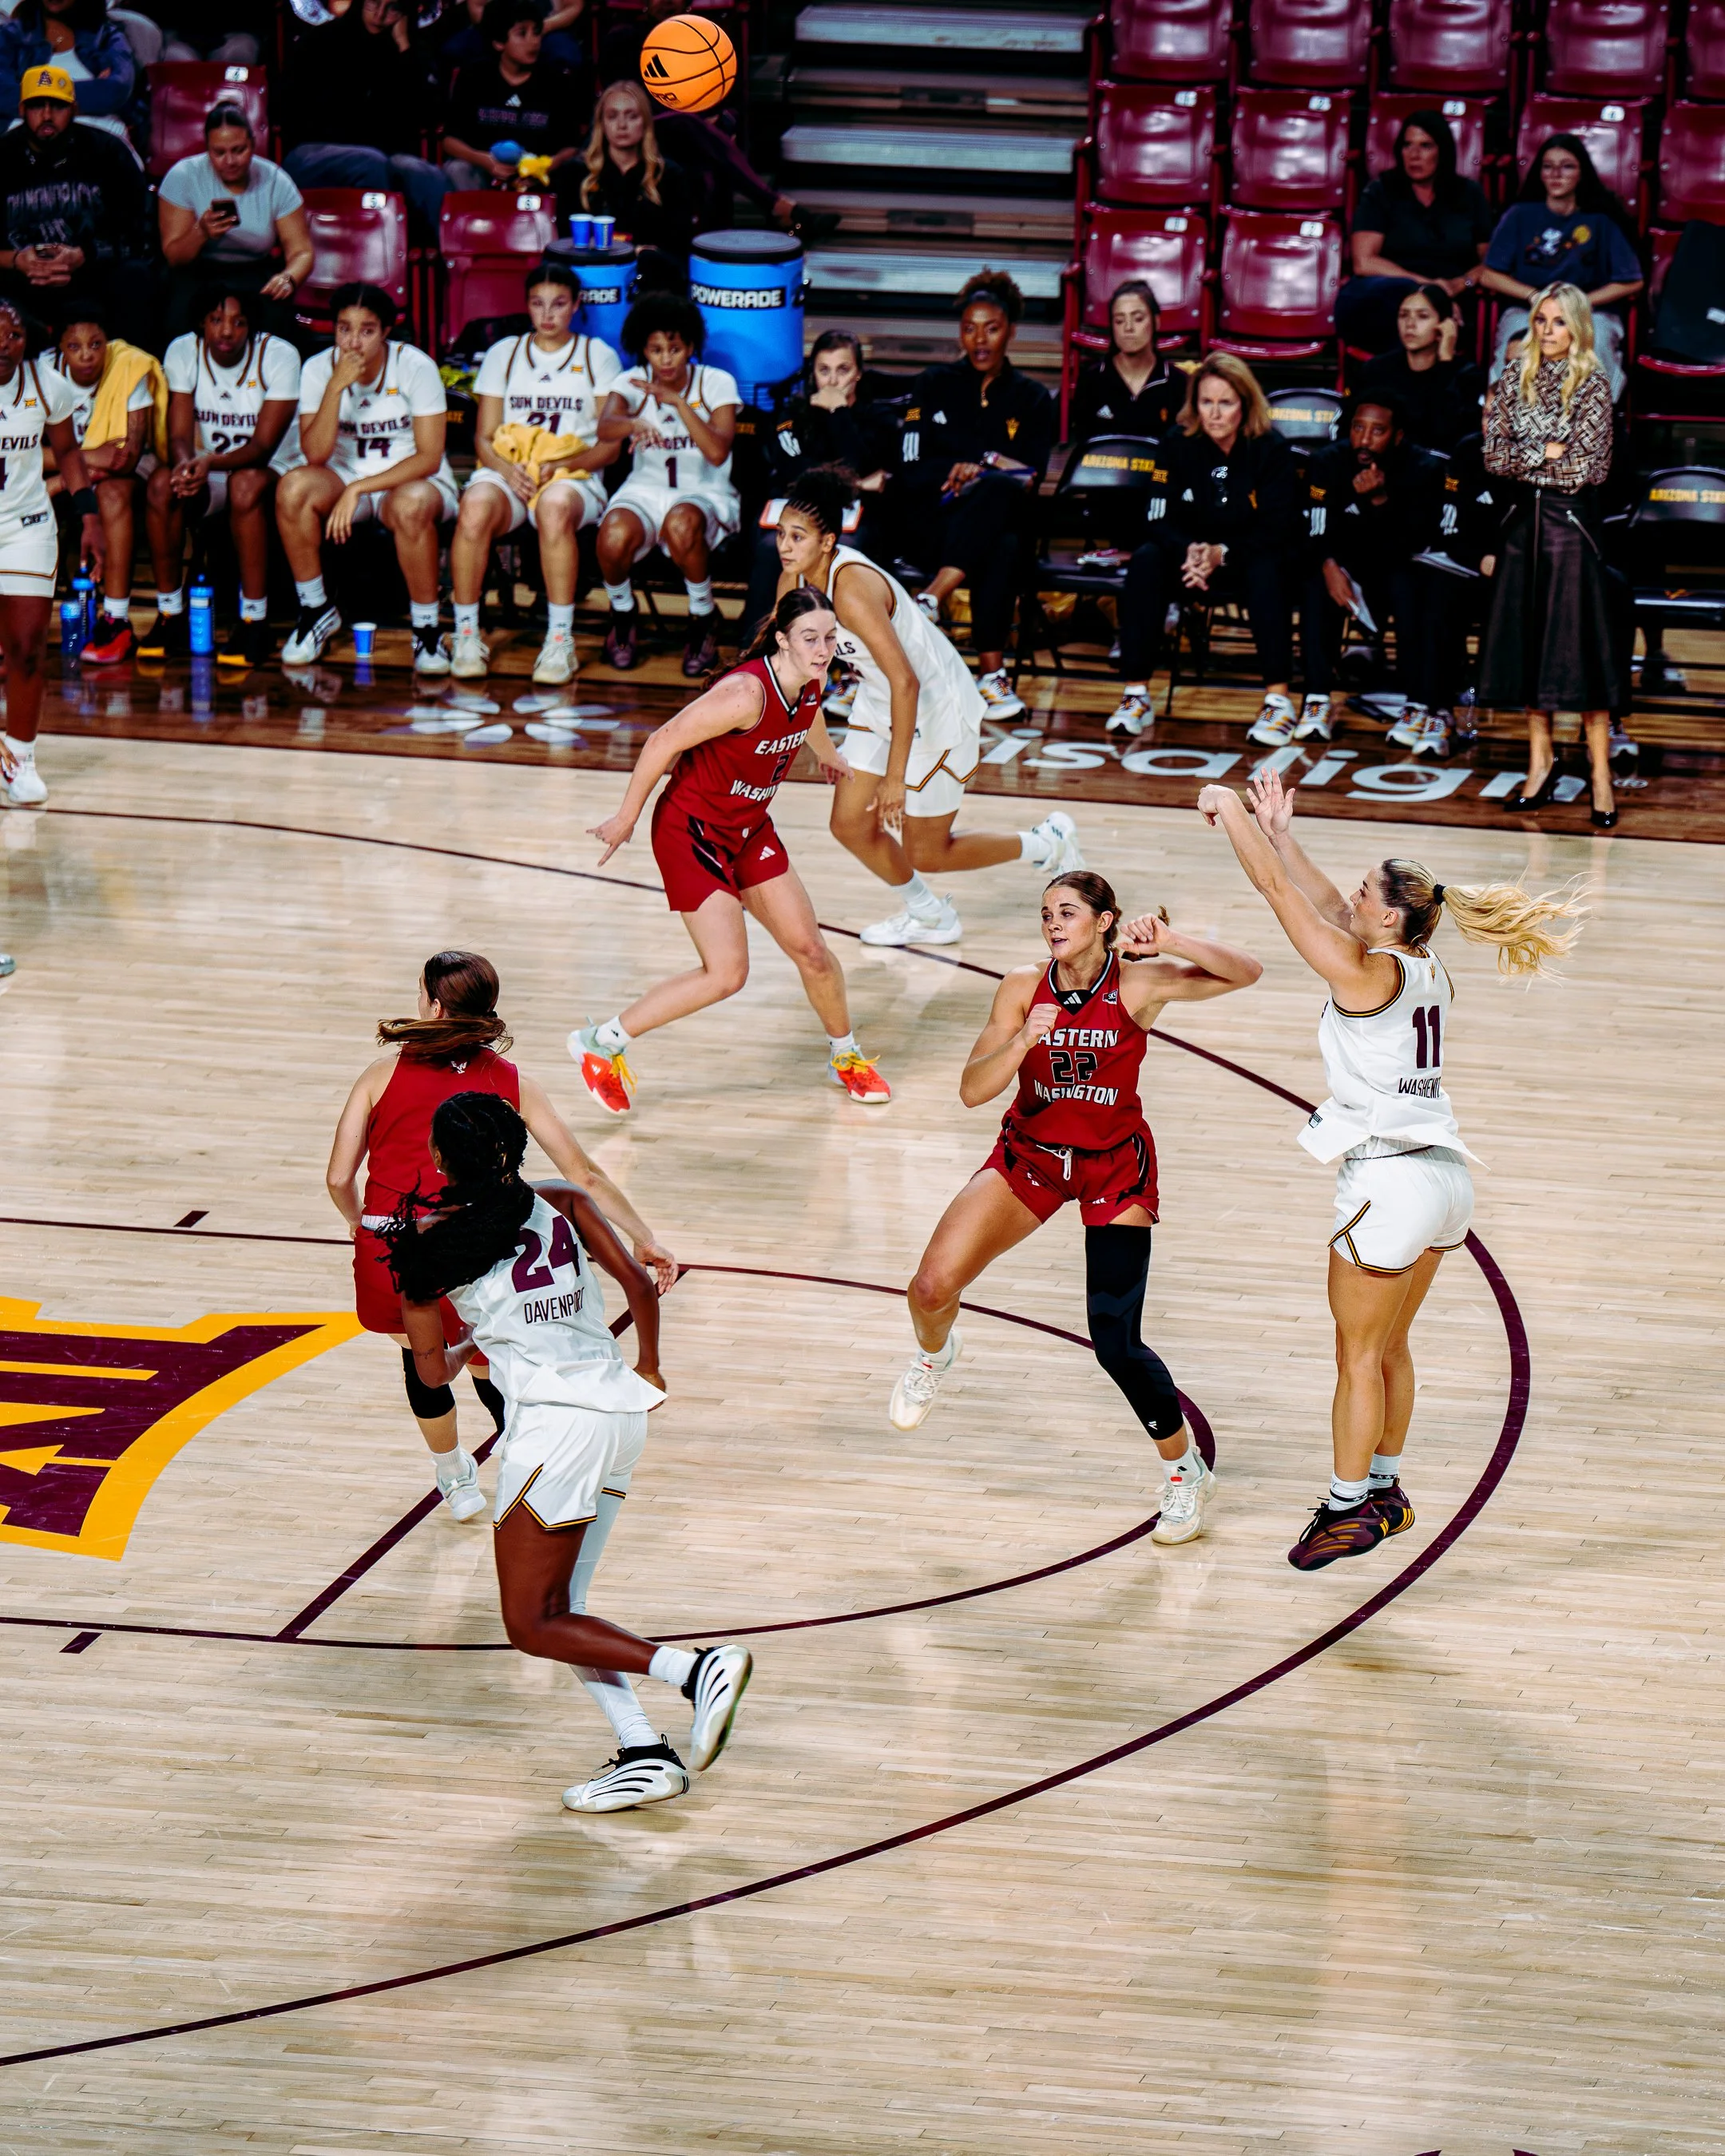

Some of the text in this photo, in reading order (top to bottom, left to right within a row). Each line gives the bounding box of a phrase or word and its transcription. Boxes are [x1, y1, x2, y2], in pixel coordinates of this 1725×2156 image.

[691, 283, 782, 309] POWERADE
[510, 396, 583, 411] SUN DEVILS
[361, 414, 411, 434] DEVILS
[355, 438, 391, 458] 14
[665, 456, 678, 488] 1
[1648, 488, 1698, 502] ARIZONA
[771, 752, 791, 785] 2
[1037, 1028, 1120, 1048] ASTERN
[1412, 1005, 1441, 1069] 11
[1049, 1050, 1098, 1084] 22
[511, 1214, 581, 1294] 24
[524, 1286, 585, 1325] DAVENPORT
